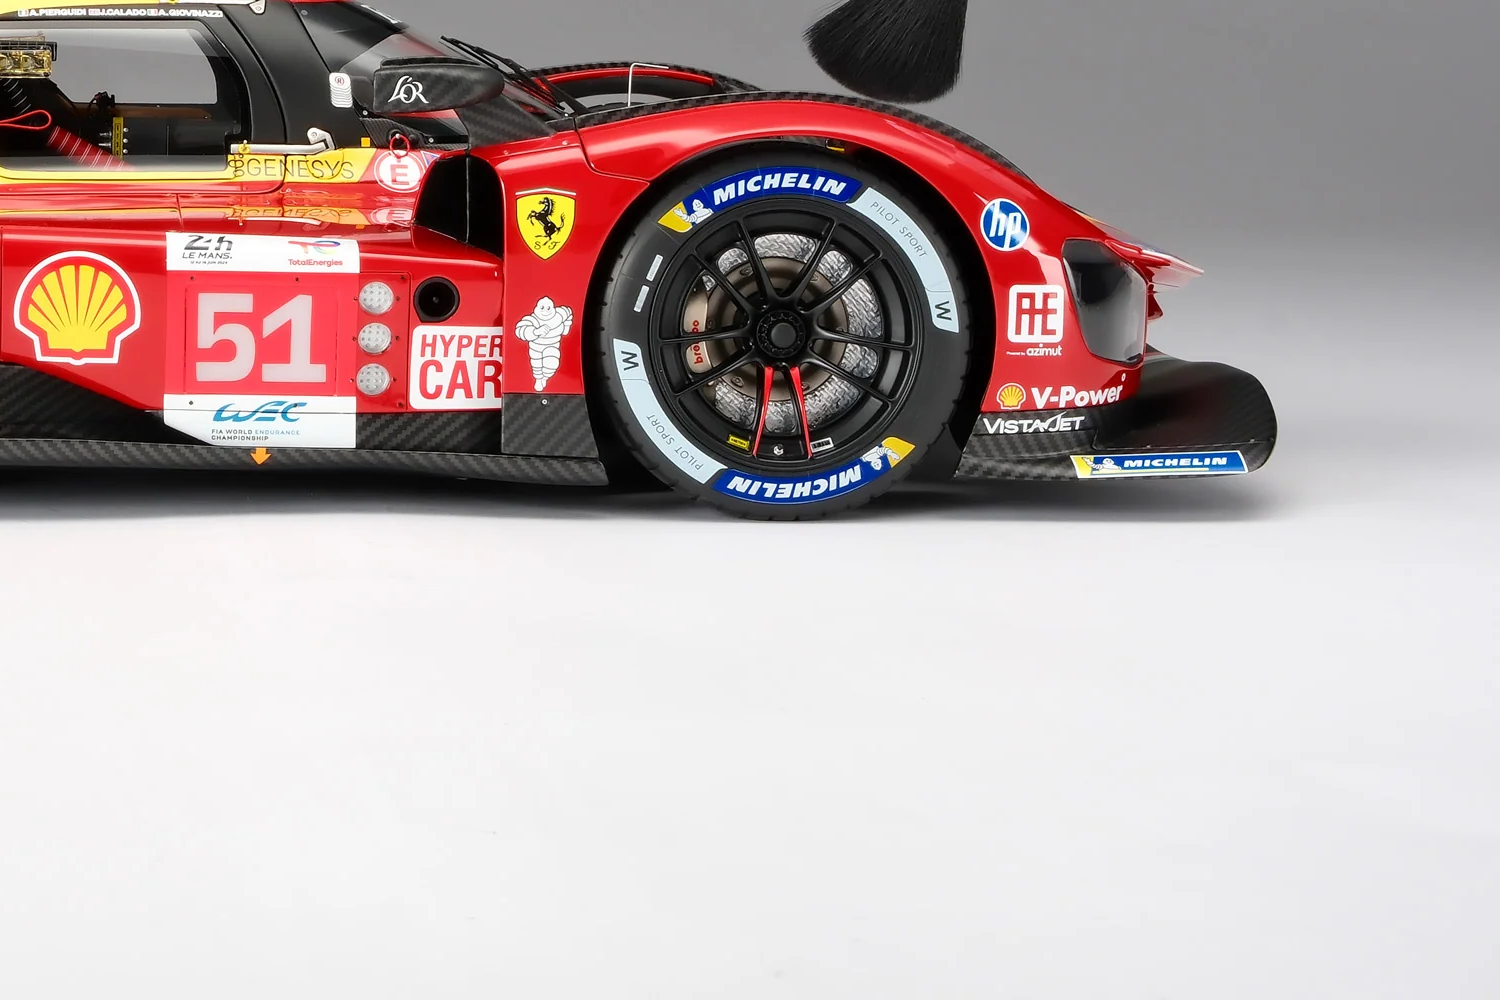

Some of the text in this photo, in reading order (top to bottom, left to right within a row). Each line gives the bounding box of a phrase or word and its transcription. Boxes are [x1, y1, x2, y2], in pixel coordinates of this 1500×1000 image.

[713, 172, 847, 206] MICHELIN
[870, 201, 928, 258] PILOT SPORT
[989, 199, 1023, 251] hp
[288, 259, 343, 268] TotalEnergies
[196, 292, 326, 384] 51
[419, 334, 502, 358] HYPER
[1026, 343, 1063, 357] azimut
[418, 359, 502, 400] CAR
[1031, 383, 1124, 410] V-Power
[212, 400, 308, 423] WEC
[646, 414, 703, 471] PILOT SPORT
[1123, 457, 1228, 468] MICHELIN
[726, 465, 862, 499] MICHELIN
